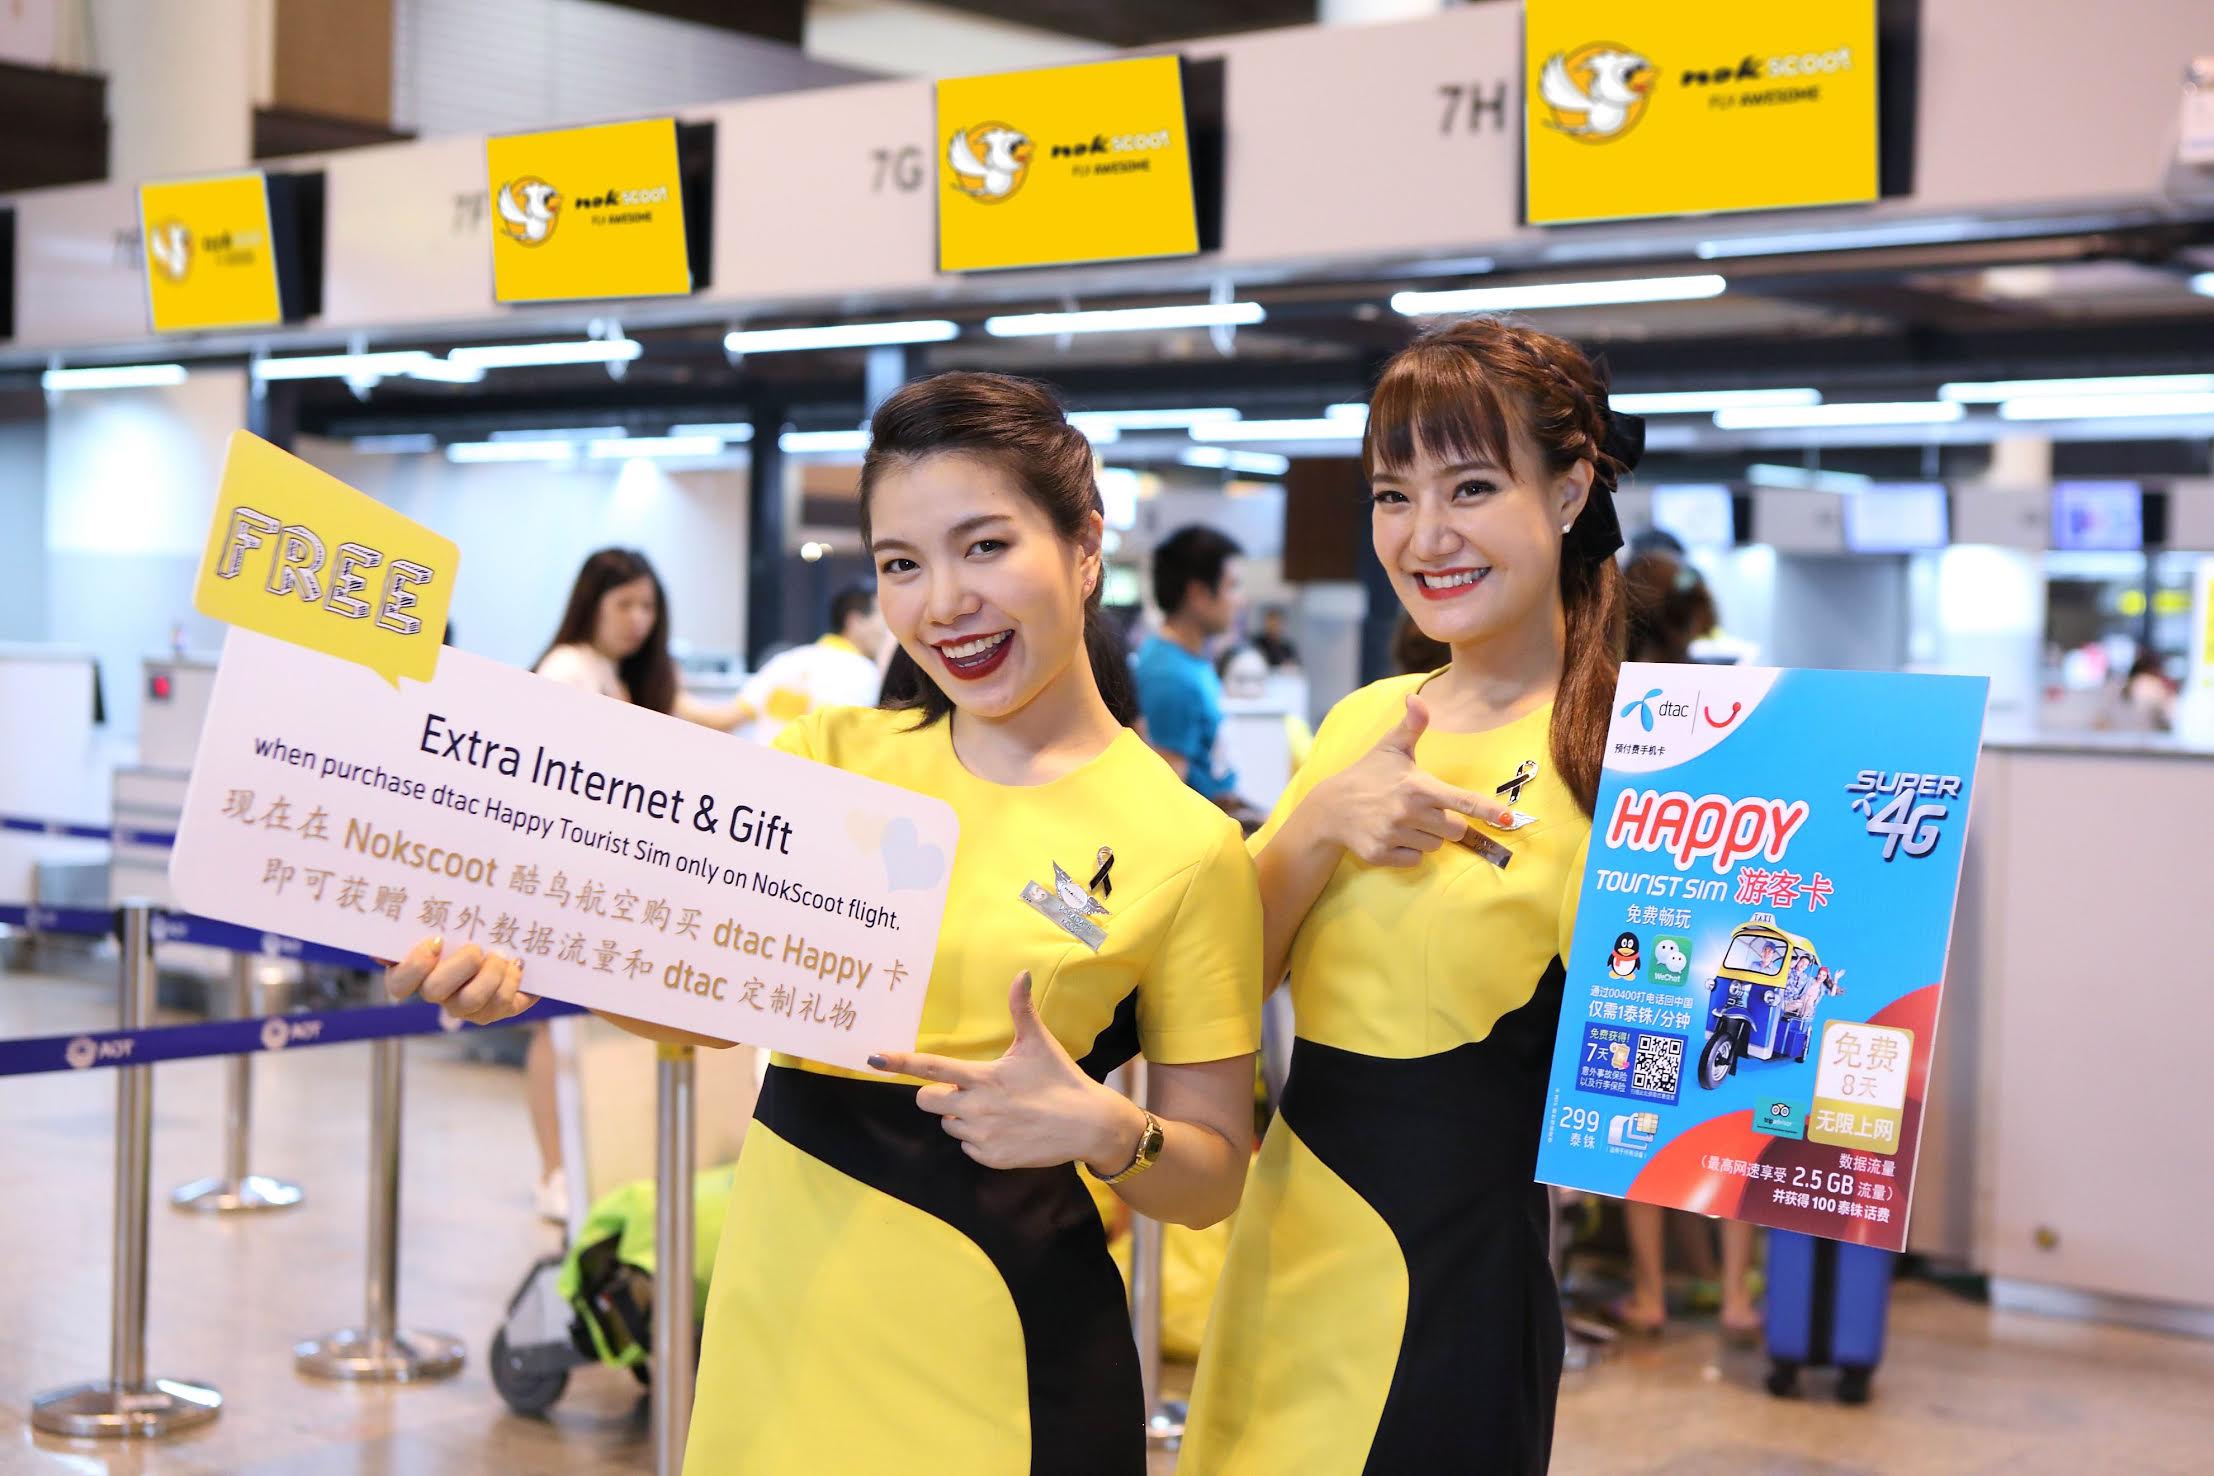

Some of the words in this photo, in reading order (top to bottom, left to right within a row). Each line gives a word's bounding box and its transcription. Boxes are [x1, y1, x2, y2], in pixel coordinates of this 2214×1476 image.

[1437, 81, 1507, 134] 7H
[1739, 84, 1820, 109] AWESOME
[870, 146, 923, 194] 7G
[1093, 159, 1151, 175] AWESOME
[216, 506, 435, 635] FREE
[1658, 701, 1689, 717] dtac
[1614, 743, 1666, 756] 预付费手机卡
[420, 713, 521, 778] Extra
[532, 746, 684, 824] Internet
[693, 794, 718, 834] &
[729, 804, 793, 855] Gift
[1844, 769, 1962, 799] SUPER
[254, 737, 316, 770] when
[321, 757, 426, 800] purchase
[432, 785, 480, 815] dtac
[484, 797, 554, 839] Happy
[560, 818, 630, 857] Tourist
[634, 840, 670, 868] Sim
[676, 855, 719, 884] only
[723, 869, 747, 888] on
[752, 872, 844, 915] NokScoot
[848, 898, 900, 931] flight.
[1866, 787, 1948, 862] 4G
[222, 788, 330, 841] 现在在
[343, 817, 499, 887] Nokscoot
[508, 864, 703, 941] 酷鸟航空购买
[714, 918, 777, 960] dtac
[782, 934, 874, 989] Happy
[883, 959, 909, 992] 卡
[1733, 866, 1835, 912] 游客卡
[1626, 903, 1692, 929] 免费畅玩
[1754, 913, 1772, 923] TAXI
[262, 857, 408, 922] 即可获赠
[416, 896, 654, 980] 额外数据流量和
[663, 960, 728, 1001] dtac
[738, 976, 858, 1031] 定制礼物
[1653, 972, 1681, 983] WeChat
[1590, 985, 1694, 1009] 通过00400打电话回中国
[1588, 1000, 1691, 1030] 仅需1泰铢/分钟
[1832, 1032, 1899, 1072] 免费
[1559, 1106, 1600, 1133] 299
[1815, 1109, 1894, 1142] 无限上网
[1569, 1132, 1595, 1149] 泰铢
[1838, 1153, 1896, 1177] 数据流量
[1792, 1167, 1822, 1190] 2.5
[1827, 1172, 1853, 1195] GB
[1772, 1188, 1809, 1209] 并获得
[1812, 1197, 1836, 1213] 100
